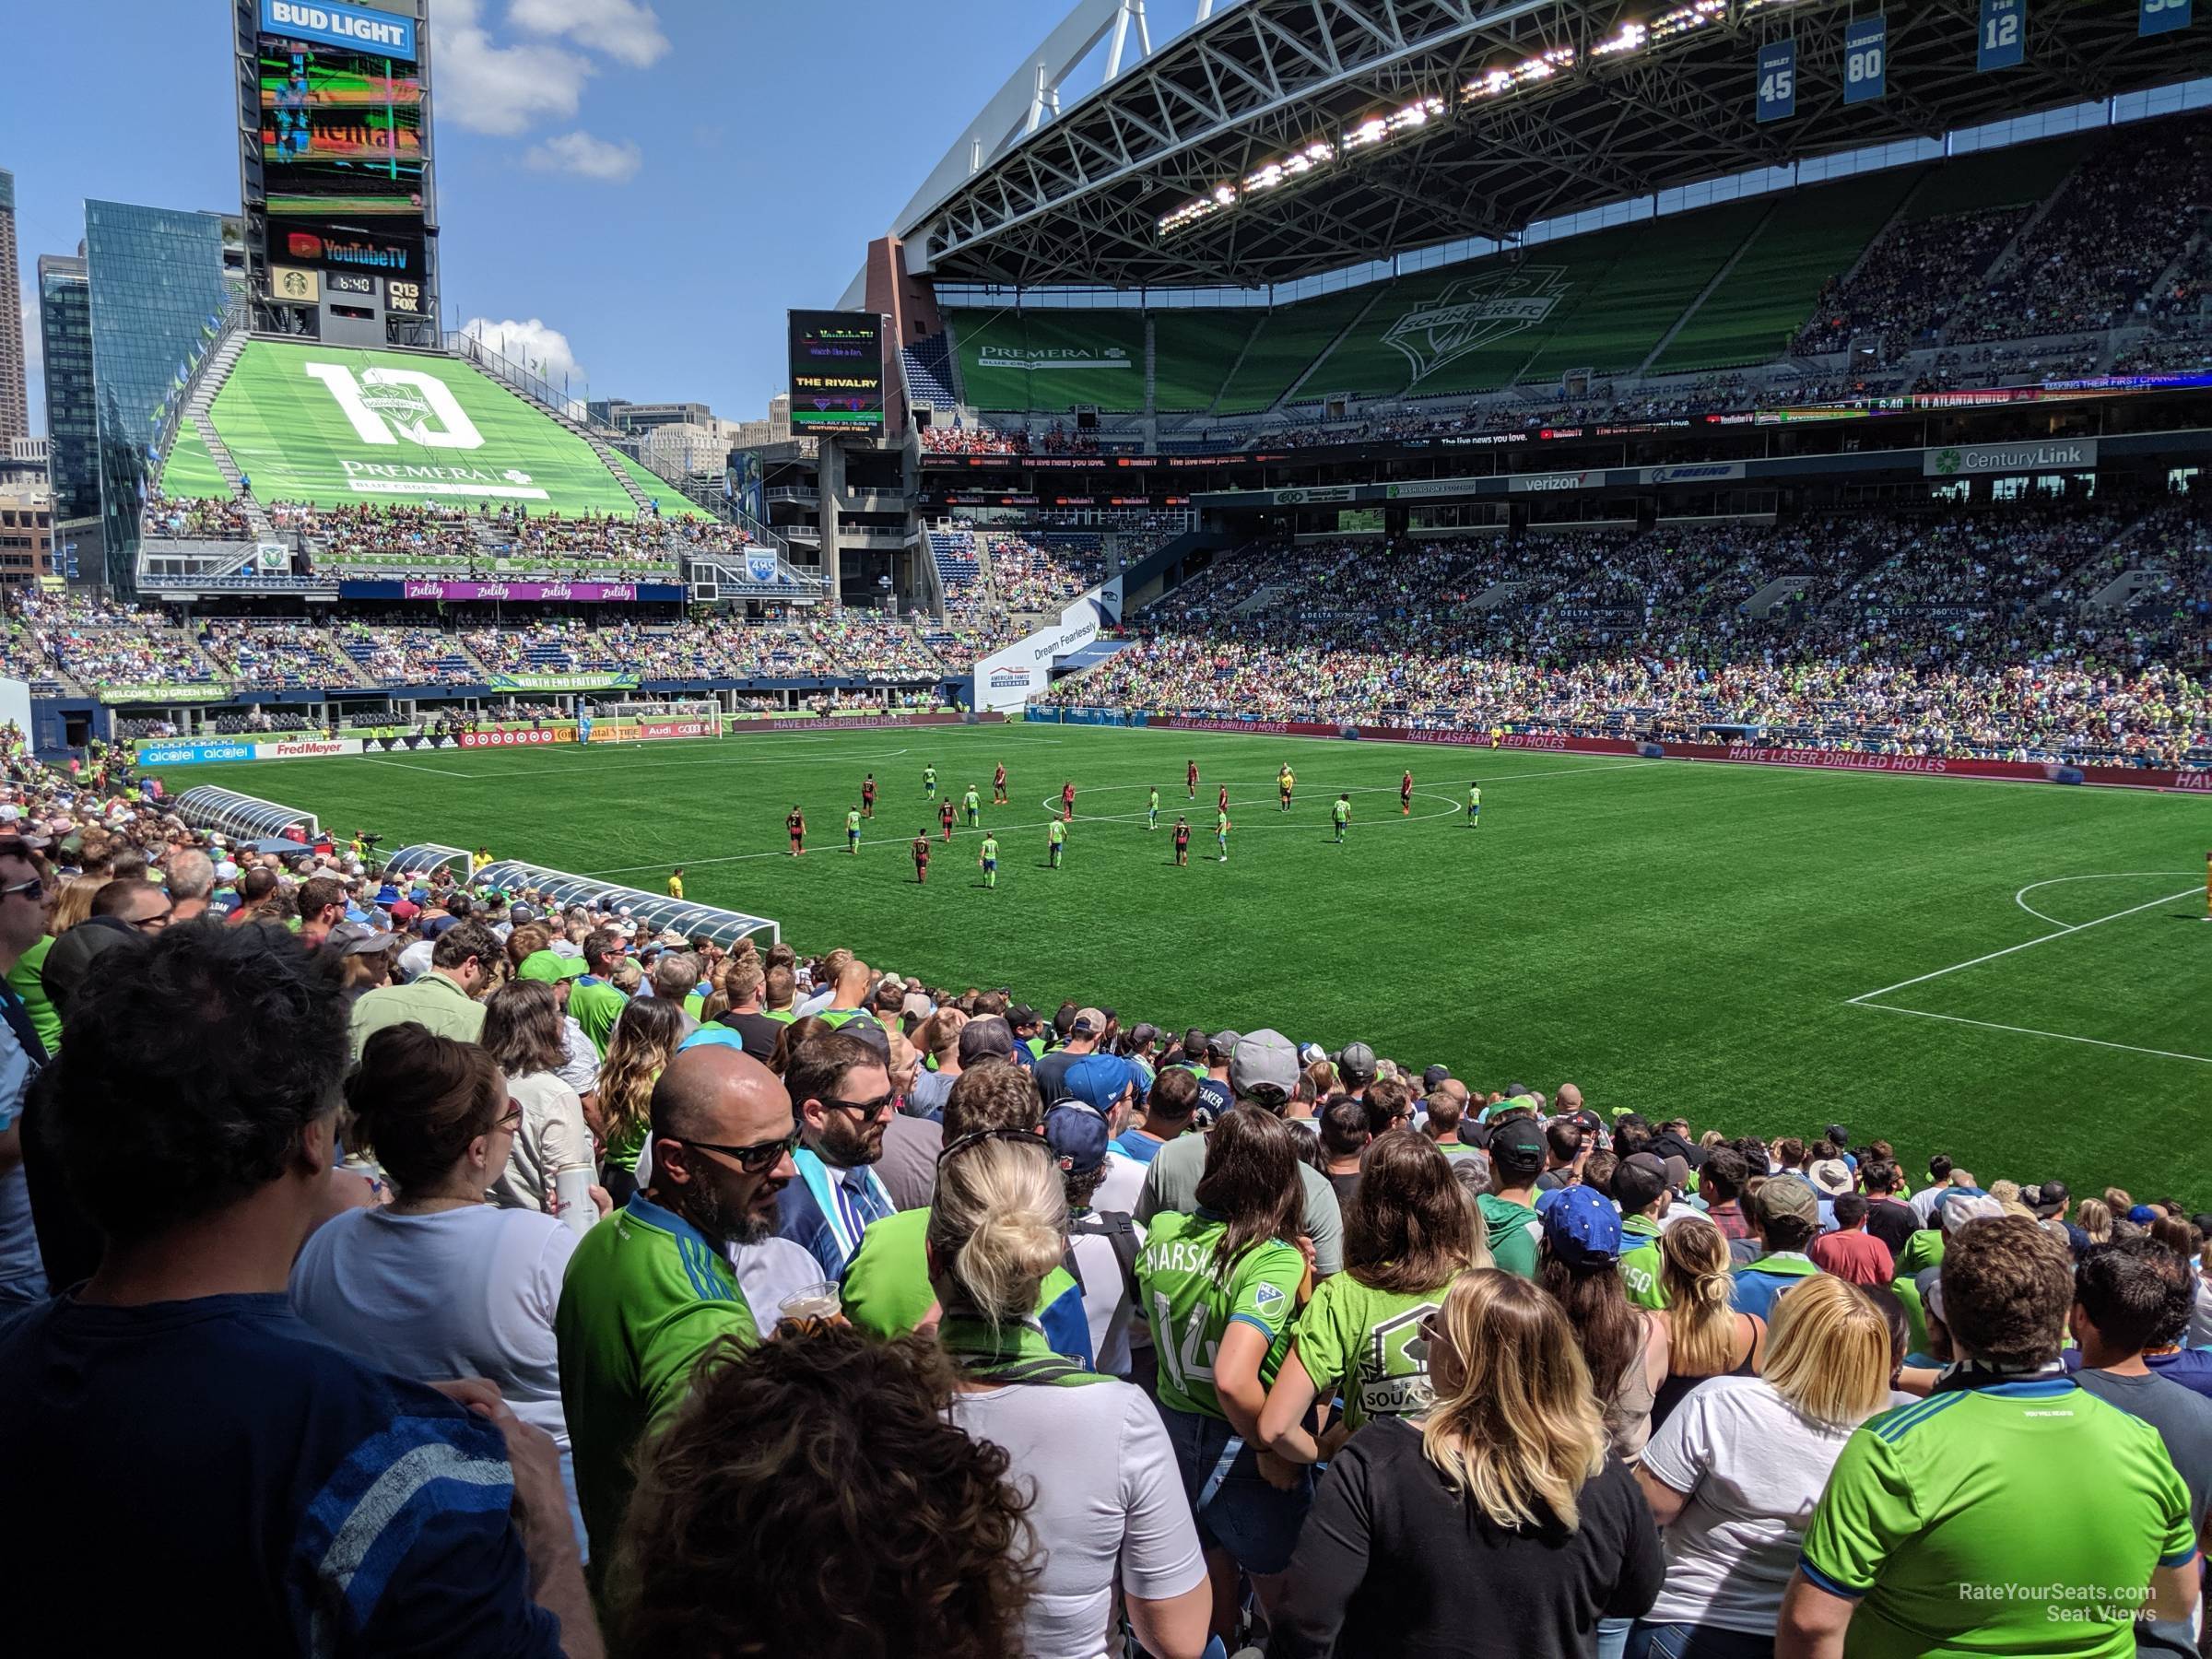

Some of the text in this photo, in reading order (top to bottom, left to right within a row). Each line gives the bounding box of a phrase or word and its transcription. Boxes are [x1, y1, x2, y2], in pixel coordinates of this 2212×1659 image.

[272, 1, 405, 46] BUD LIGHT
[1984, 14, 2018, 50] 12
[1848, 48, 1882, 83] 80
[1759, 70, 1793, 102] 45
[340, 277, 370, 291] 6:40
[389, 281, 419, 298] Q13
[392, 297, 418, 312] FOX
[1517, 305, 1544, 316] FC
[981, 346, 1091, 359] PREMERA
[795, 377, 877, 388] THE RIVALRY
[2082, 379, 2110, 389] THEIR
[2111, 377, 2137, 387] FIRST
[305, 361, 486, 450] 10
[1932, 394, 1973, 408] ATLANTA
[1975, 391, 2009, 406] UNITED
[1456, 437, 1471, 445] live
[1472, 436, 1491, 444] news
[1493, 434, 1508, 443] you
[1509, 432, 1528, 442] love.
[1072, 458, 1088, 468] you
[1965, 446, 2082, 468] CenturyLink
[339, 460, 491, 482] PREMERA
[1670, 466, 1731, 477] BOEING
[355, 481, 388, 490] BLUE
[1525, 476, 1580, 491] verizon
[1034, 621, 1097, 661] Dream Fearlessly
[518, 676, 613, 688] NORTH END FAITHFUL
[102, 686, 225, 700] WELCOME TO GREEN HELL
[774, 714, 912, 729] HAVE LASER-DRILLED HOLES
[1170, 718, 1288, 734] HAVE LASER-DRILLED HOLES
[649, 725, 672, 735] Audi
[1406, 729, 1435, 741] HAVE
[1525, 736, 1566, 749] HOLES
[148, 749, 194, 762] alcatel
[204, 747, 248, 760] alcatel
[1728, 747, 1947, 772] HAVE LASER-DRILLED HOLES
[1260, 1283, 1278, 1297] MLS
[1154, 1290, 1218, 1396] 14
